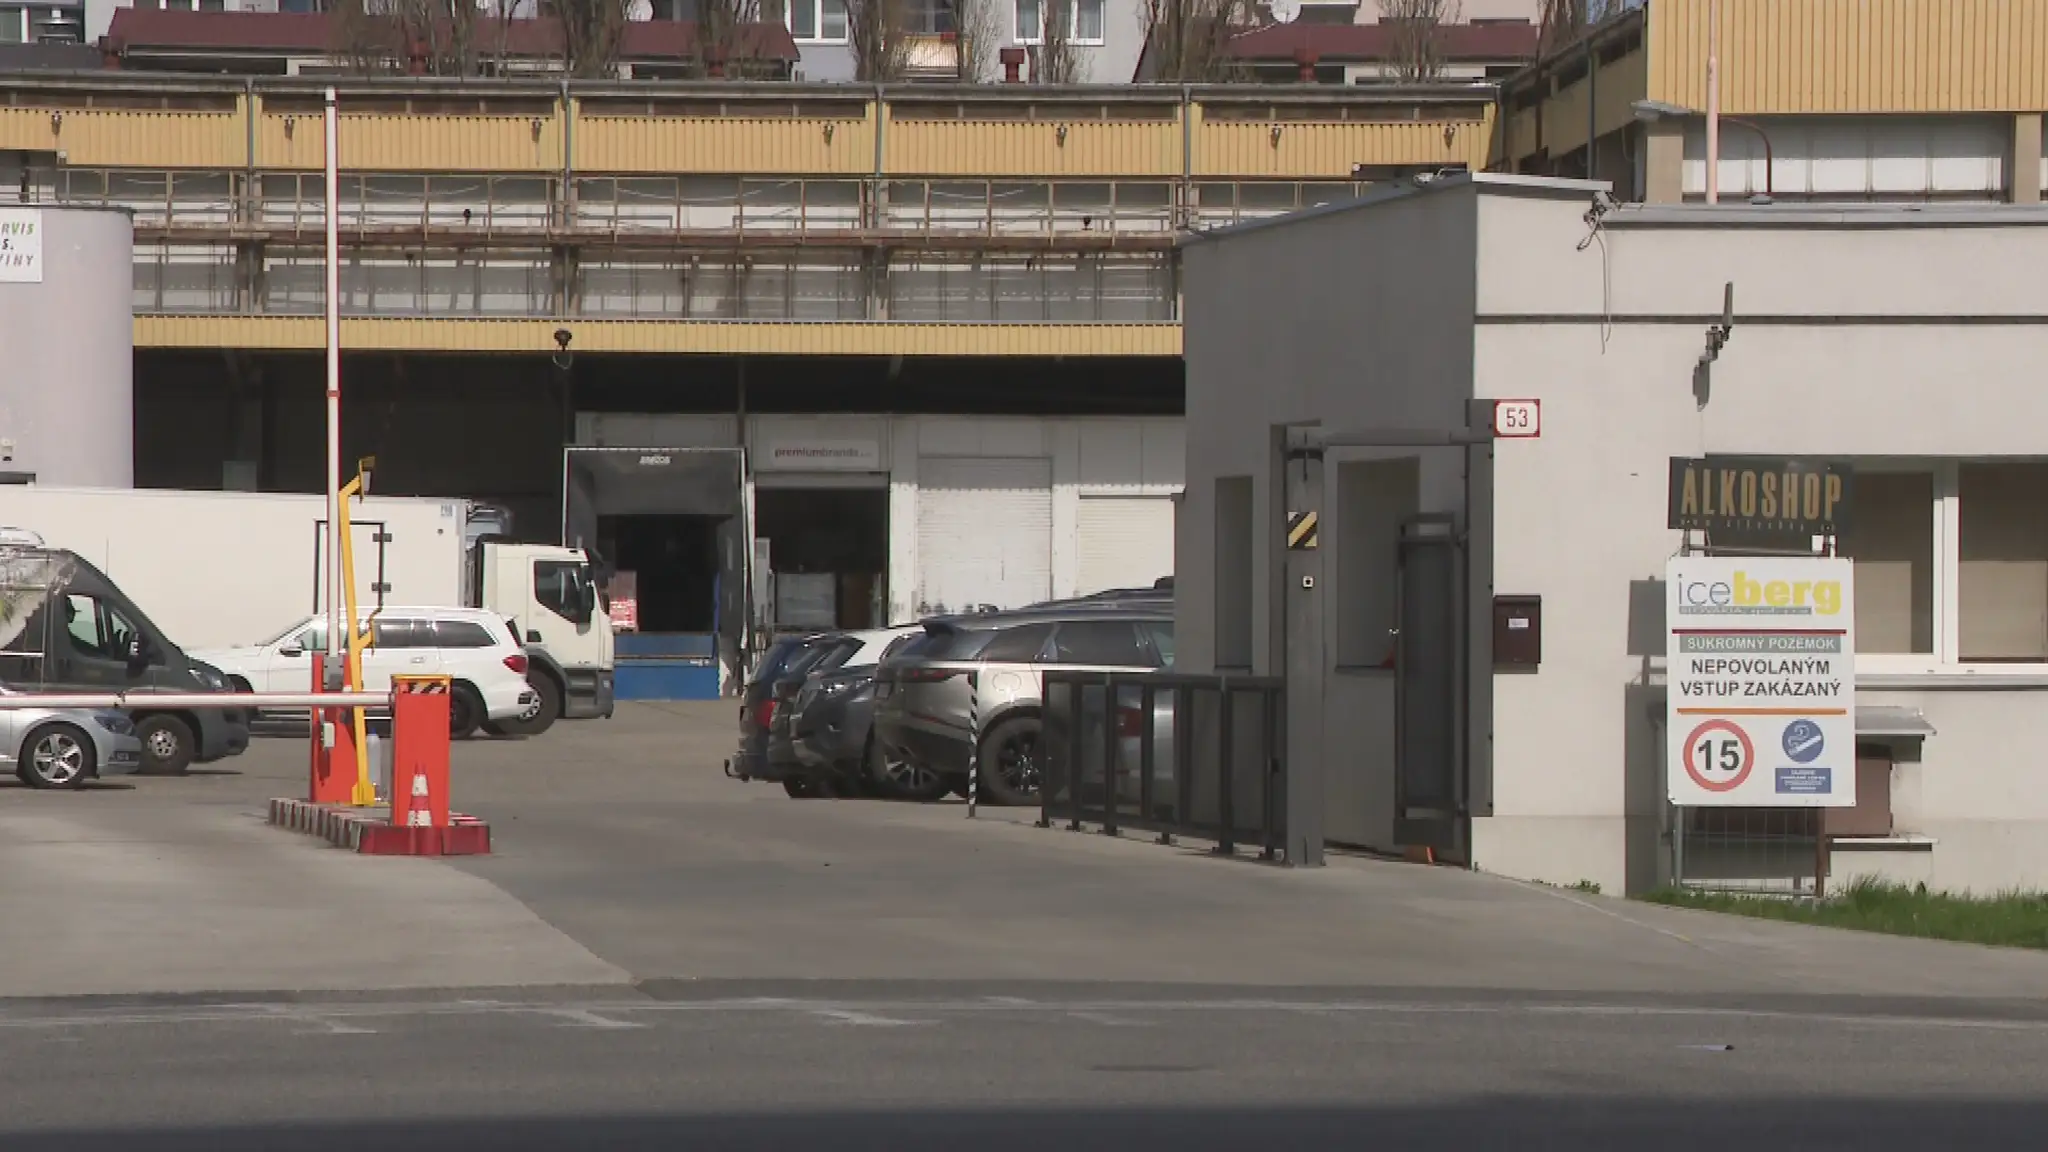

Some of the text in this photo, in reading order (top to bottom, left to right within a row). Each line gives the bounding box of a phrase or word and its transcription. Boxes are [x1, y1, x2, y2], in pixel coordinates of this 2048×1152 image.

[1506, 407, 1528, 428] 53
[1681, 467, 1842, 521] ALKOSHOP
[1678, 570, 1842, 615] iceberg
[1768, 637, 1836, 649] POZEMOK
[1691, 657, 1830, 675] NEPOVOLANÝM
[1680, 678, 1841, 696] VSTUP ZAKÁZANÝ
[1698, 740, 1740, 771] 15
